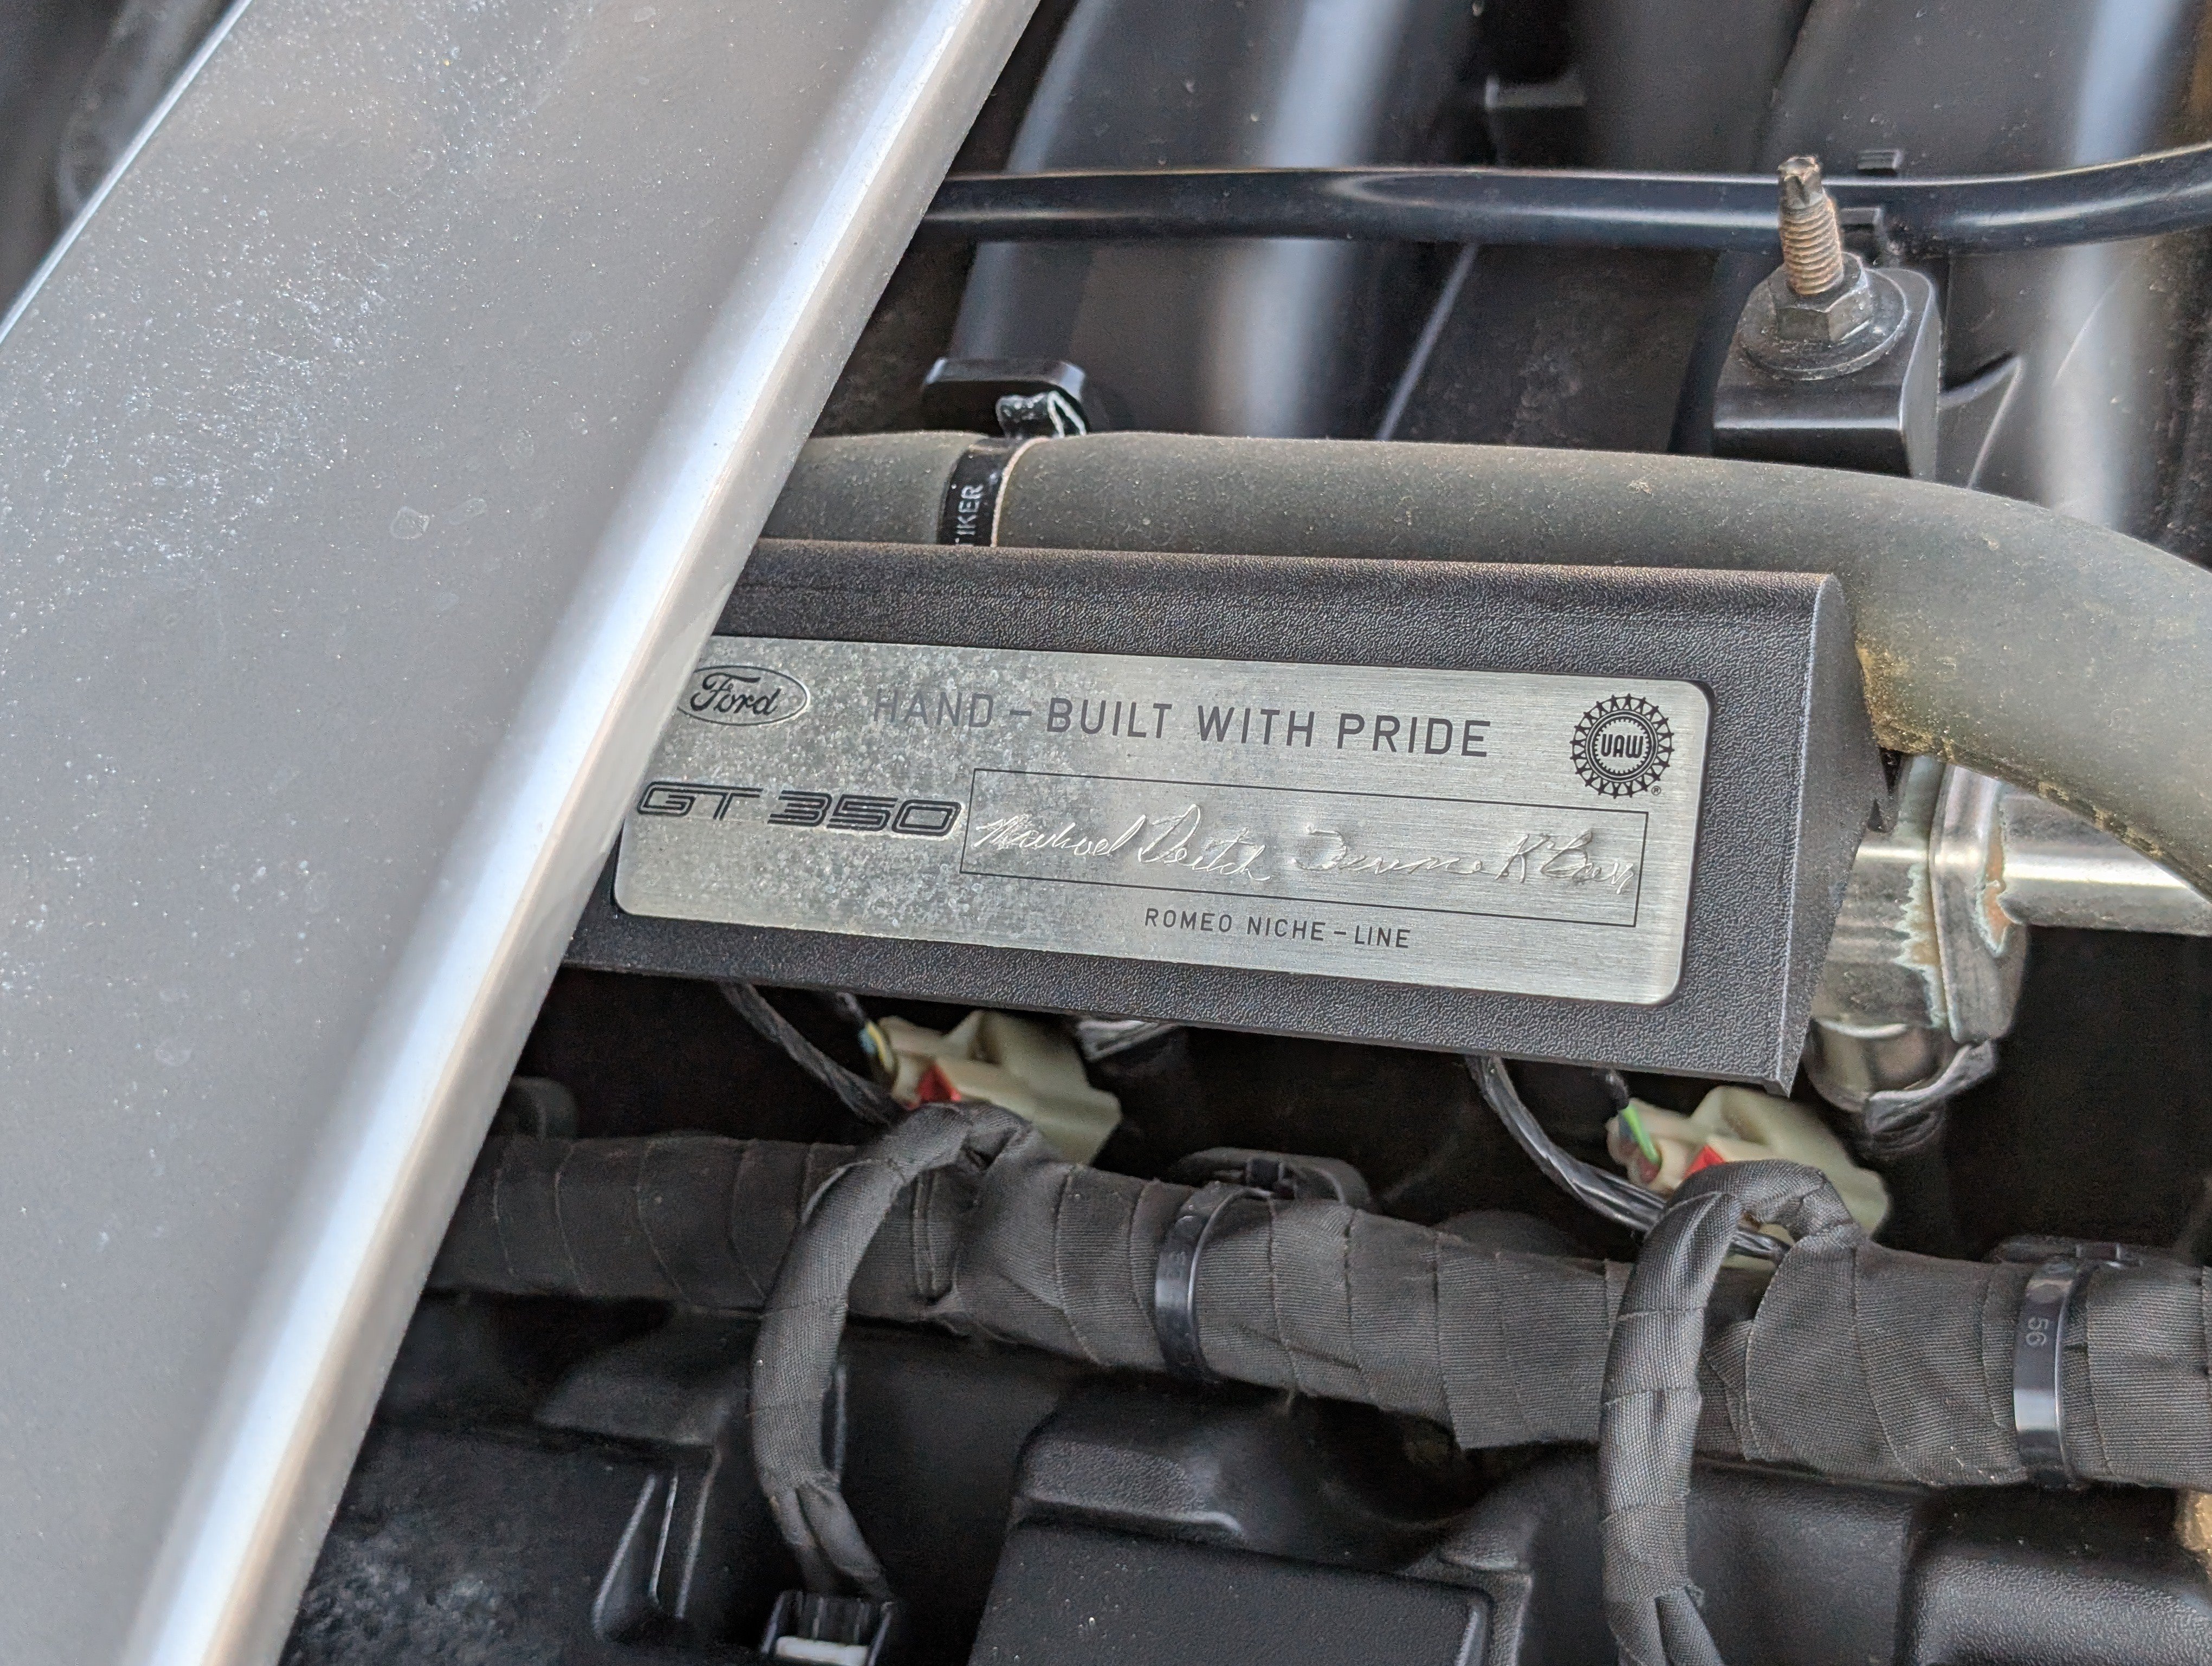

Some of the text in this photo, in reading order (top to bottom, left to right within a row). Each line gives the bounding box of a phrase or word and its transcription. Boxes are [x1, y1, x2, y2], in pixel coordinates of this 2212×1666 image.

[691, 672, 782, 715] Ford
[1198, 704, 1315, 747] WITH
[1337, 713, 1491, 757] PRIDE
[1600, 734, 1644, 758] UAW
[636, 781, 963, 837] GT 350
[1144, 908, 1233, 934] ROMEO
[2025, 1316, 2049, 1348] 56
